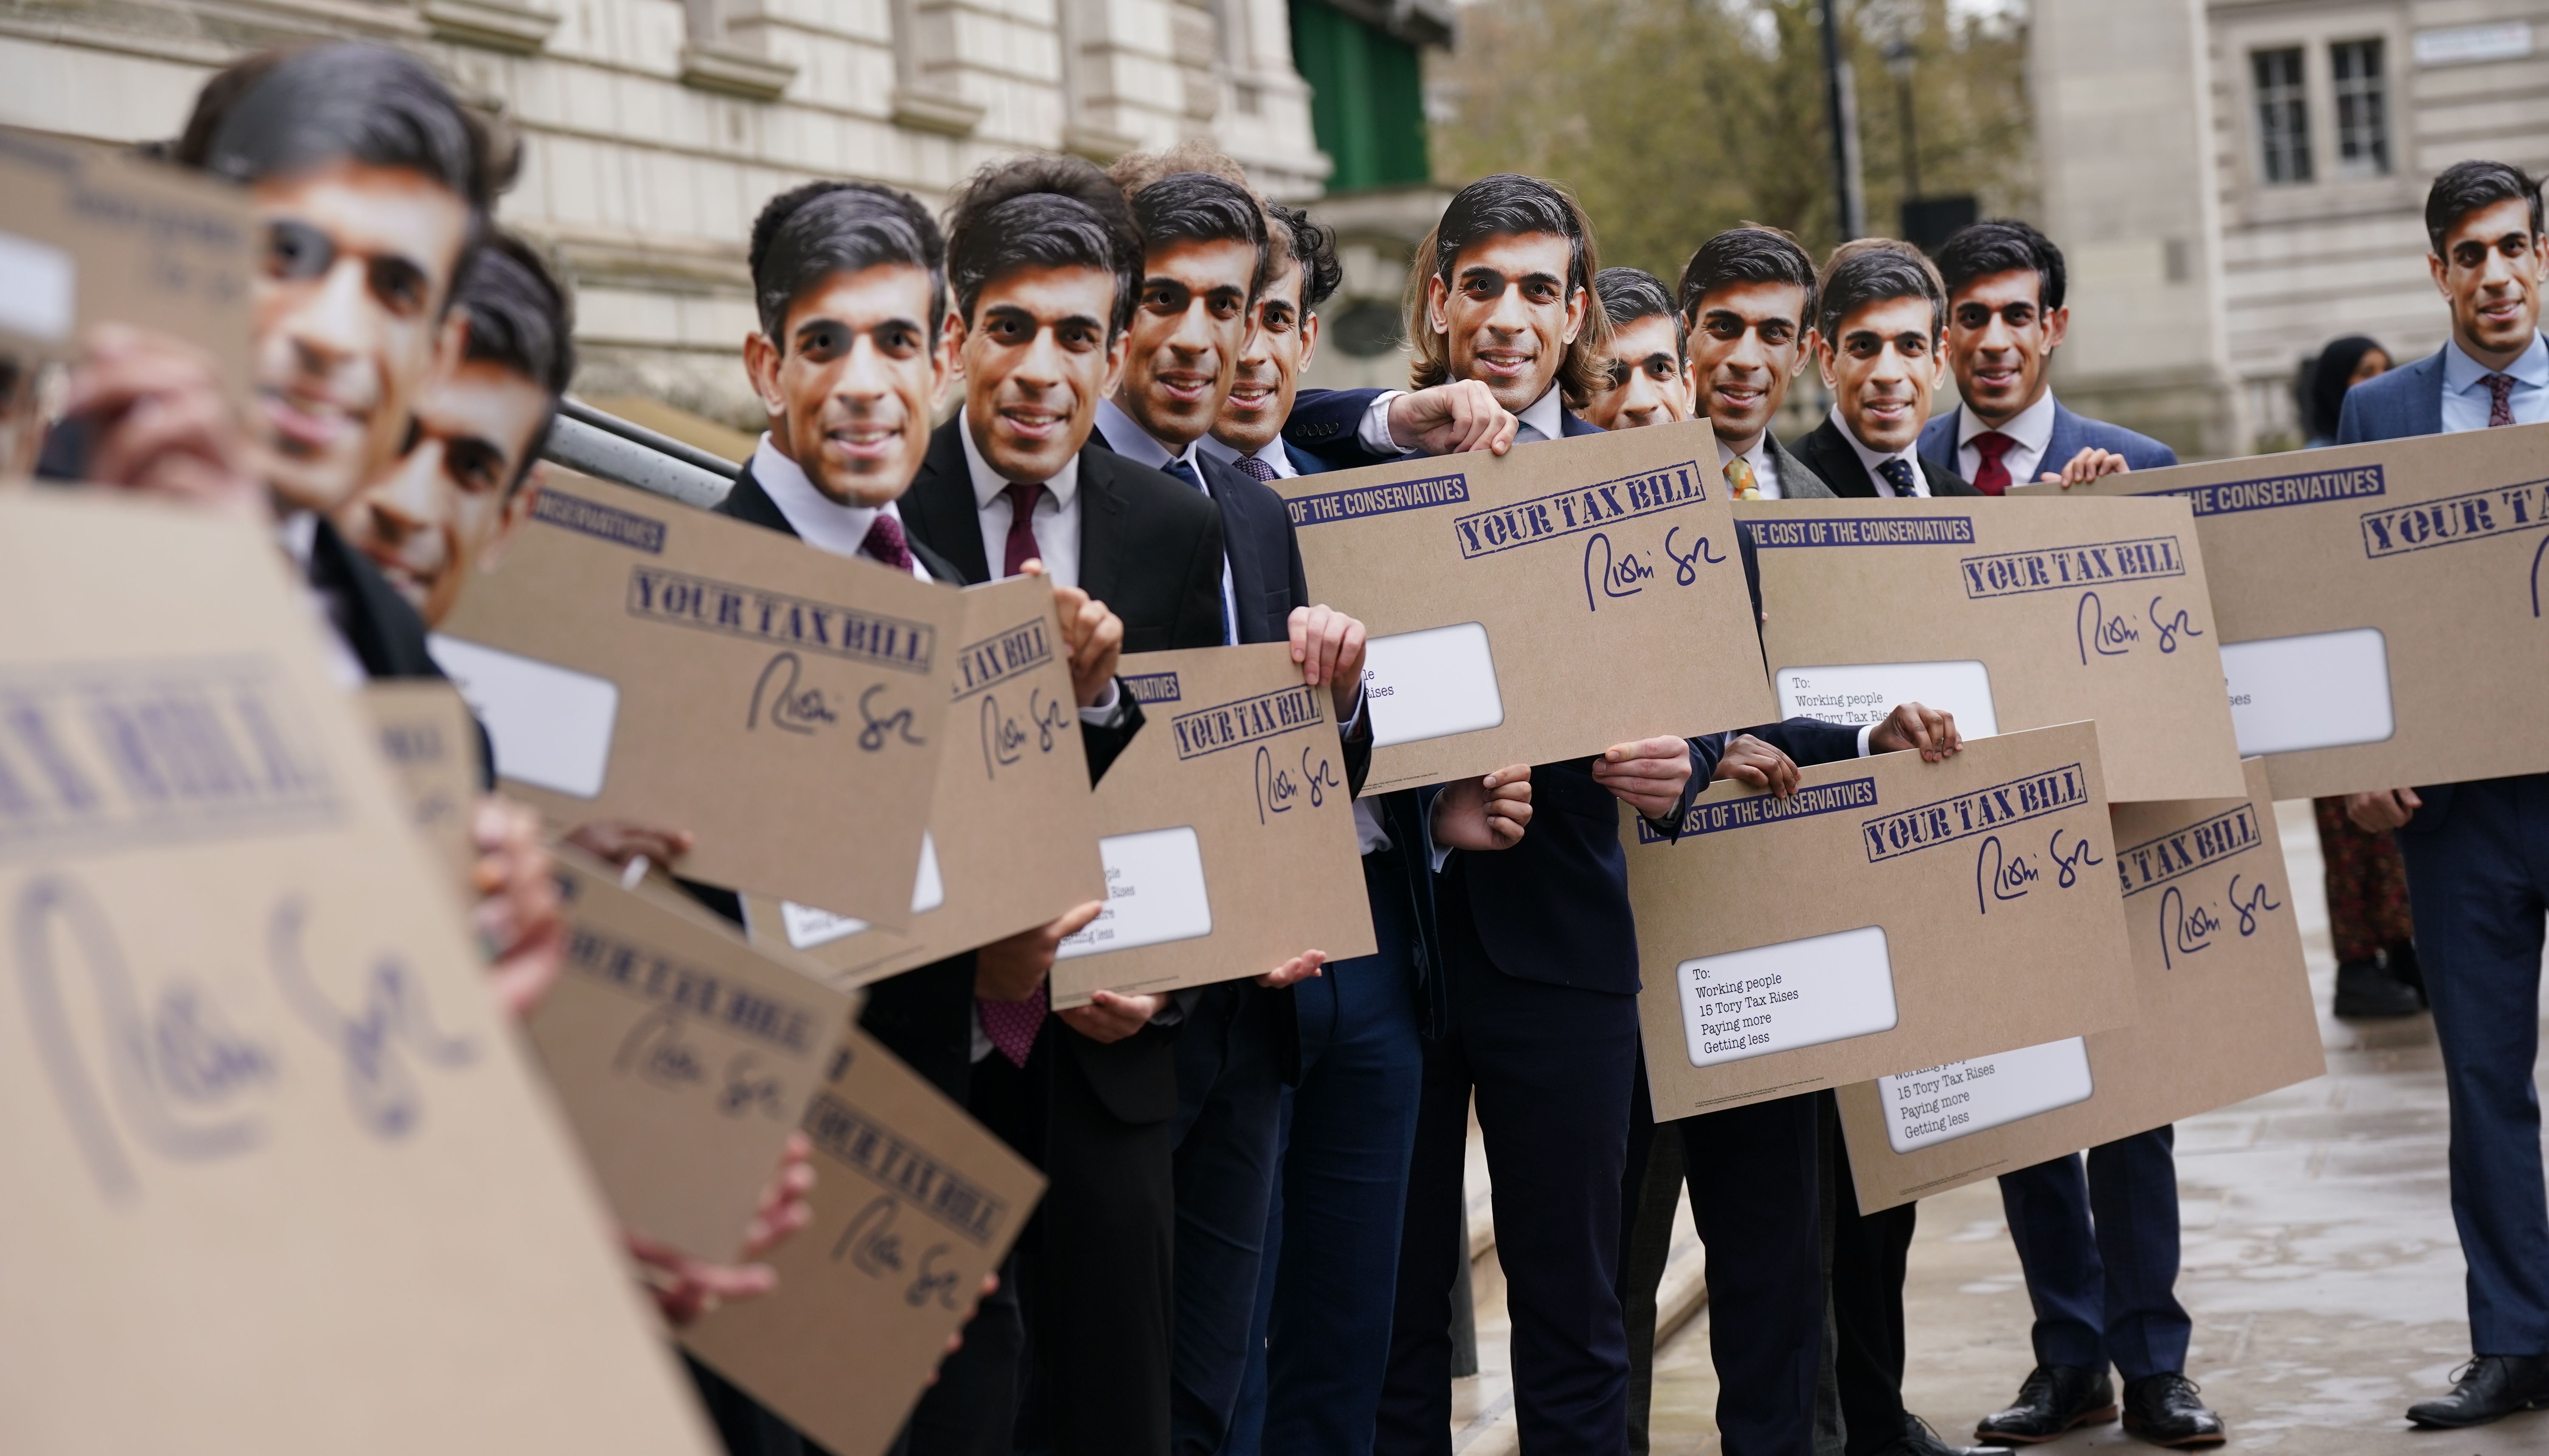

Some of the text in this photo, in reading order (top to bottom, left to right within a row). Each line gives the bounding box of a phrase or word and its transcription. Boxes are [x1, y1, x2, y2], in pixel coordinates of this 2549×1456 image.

[1288, 478, 1464, 523] OF THE CONSERVATIVES
[2173, 469, 2378, 512] HE CONSERVATIVES
[536, 494, 658, 548] NSERVATIVES
[1459, 468, 1699, 551] YOUR TAX BILL
[1769, 522, 1805, 544] COST
[1810, 522, 1827, 543] OF
[1830, 522, 1859, 542] THE
[1861, 519, 1970, 542] CONSERVATIVES
[2367, 499, 2495, 549] YOUR
[1965, 542, 2181, 592] YOUR TAX BILL
[639, 574, 926, 668] YOUR TAX BILL
[957, 626, 1048, 688] TAX BILL
[1124, 676, 1178, 700] RVATIVES
[1792, 677, 1811, 688] To:
[1795, 692, 1883, 707] Working people
[2229, 694, 2251, 707] ses
[1175, 689, 1321, 753] YOUR TAX BILL
[1846, 711, 1868, 722] Tax
[1870, 710, 1890, 721] Ris
[1682, 809, 1707, 832] OST
[1712, 805, 1729, 827] OF
[1732, 800, 1761, 824] THE
[1763, 781, 1873, 818] CONSERVATIVES
[1868, 772, 2083, 854] YOUR TAX BILL
[2133, 835, 2193, 882] TAX
[2193, 813, 2257, 860] BILL
[1096, 929, 1115, 940] less
[1693, 968, 1711, 980] To:
[1696, 973, 1782, 999] Working people
[1700, 990, 1799, 1017] 15 Tory Tax Rises
[1701, 1013, 1772, 1036] Paying more
[1704, 1032, 1770, 1054] Getting less
[1898, 1087, 1911, 1100] 15
[1913, 1081, 1939, 1095] Tory
[1942, 1075, 1964, 1088] Tax
[1966, 1063, 1995, 1081] Rises
[1901, 1092, 1970, 1120] Paying more
[1905, 1112, 1970, 1139] Getting less
